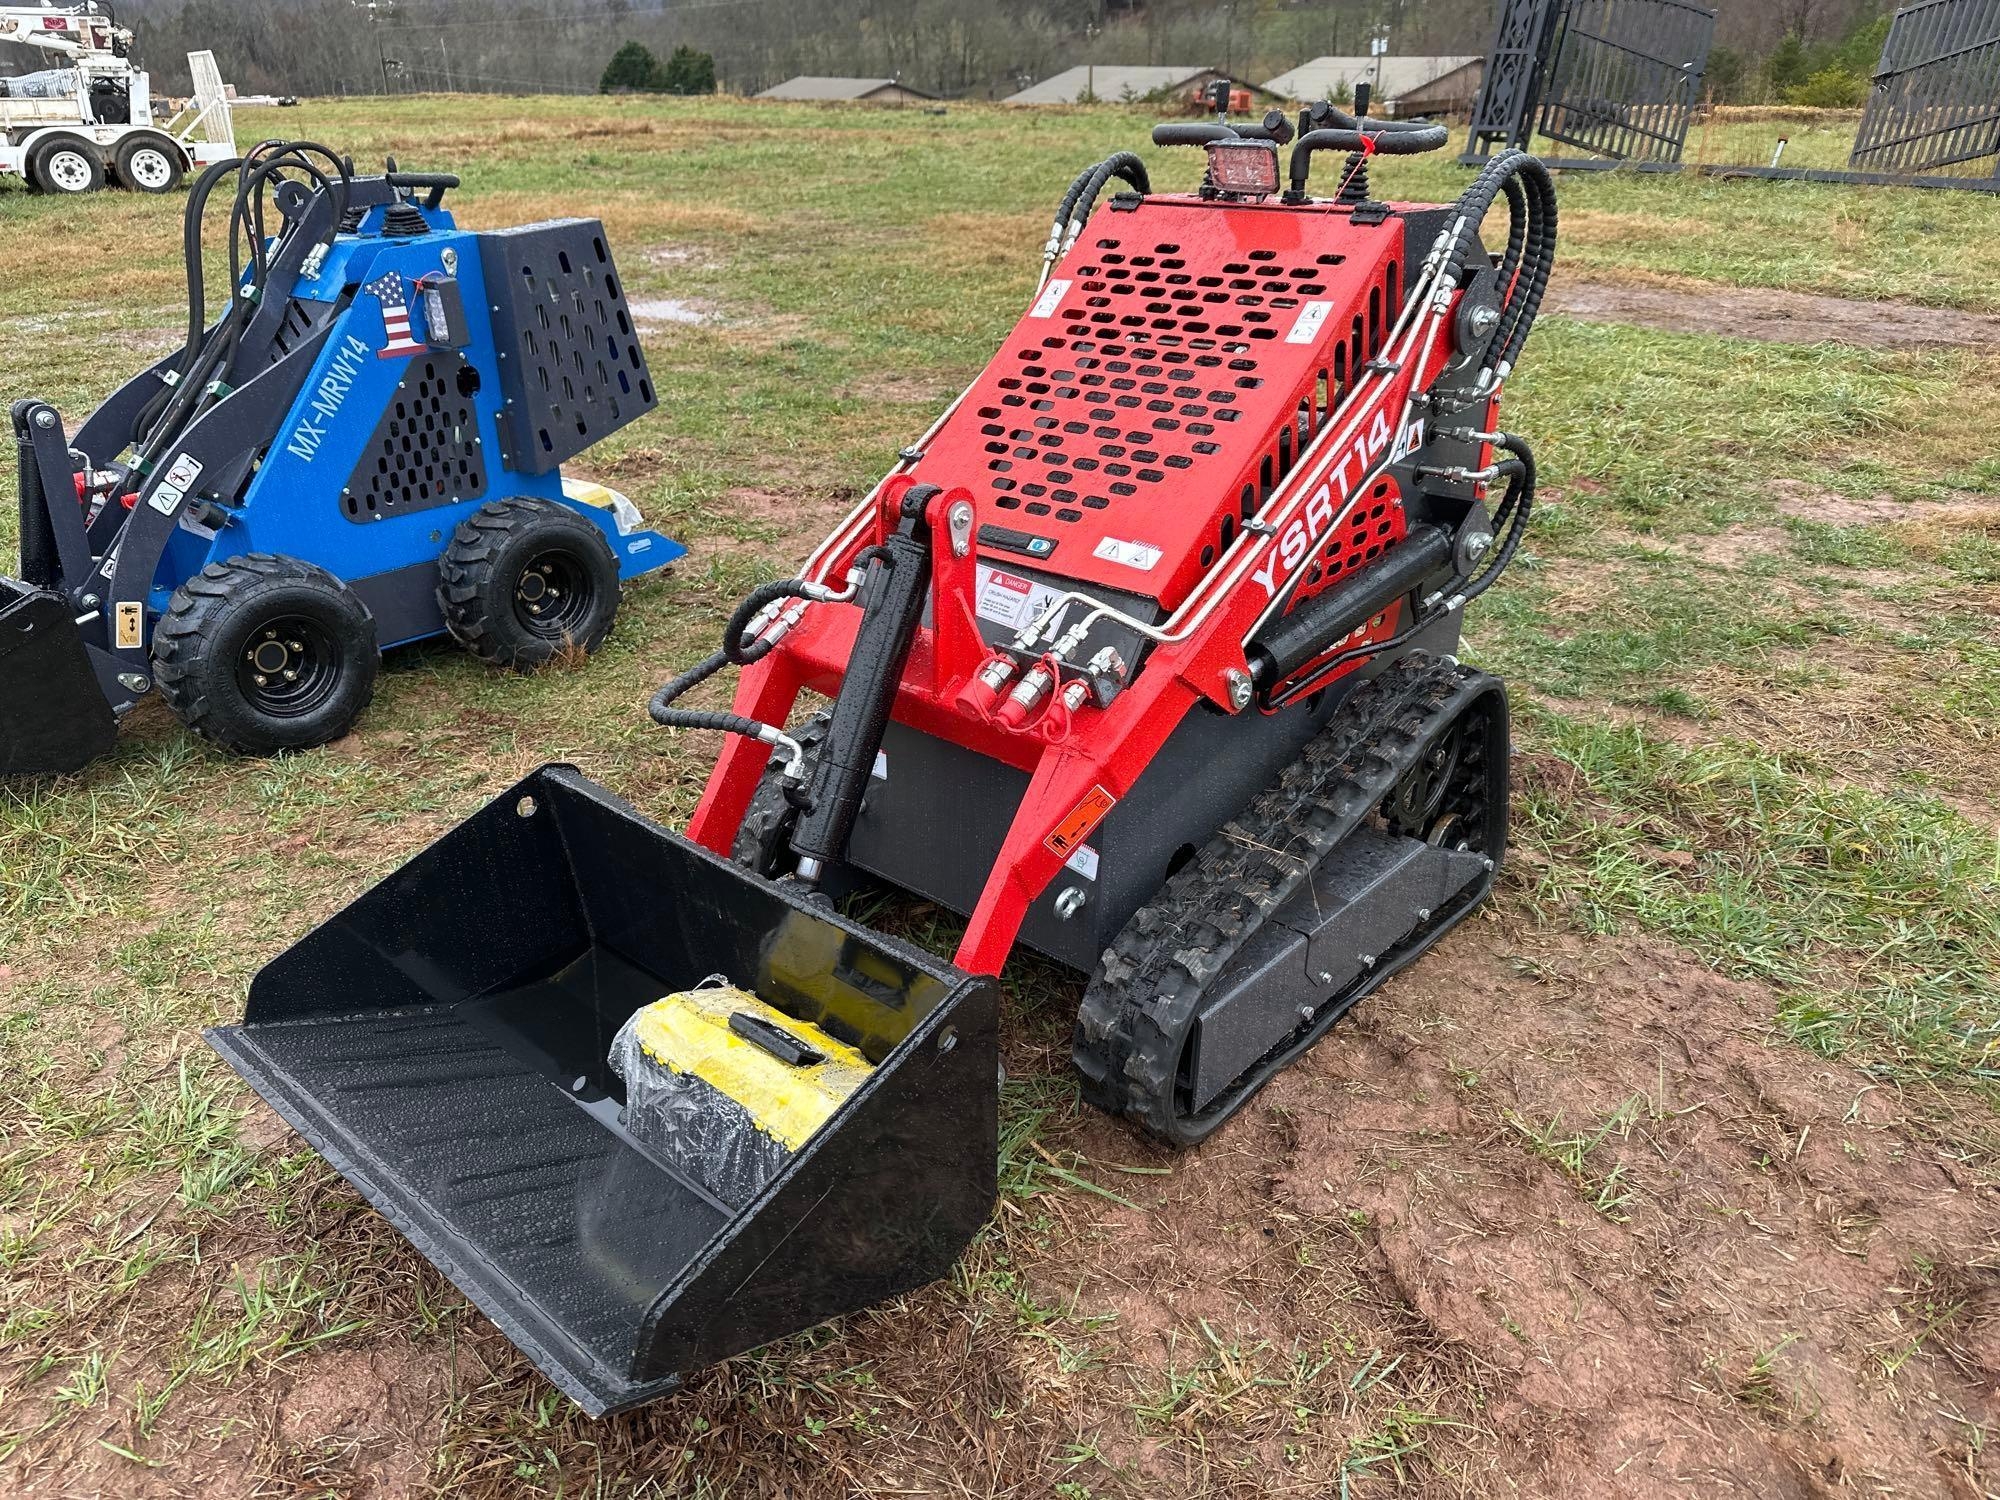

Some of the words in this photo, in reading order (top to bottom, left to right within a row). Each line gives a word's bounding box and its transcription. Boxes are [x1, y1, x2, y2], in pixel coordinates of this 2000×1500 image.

[287, 334, 370, 463] MX-MRW14
[1251, 408, 1391, 598] YSRT14
[1004, 578, 1028, 591] DANGER
